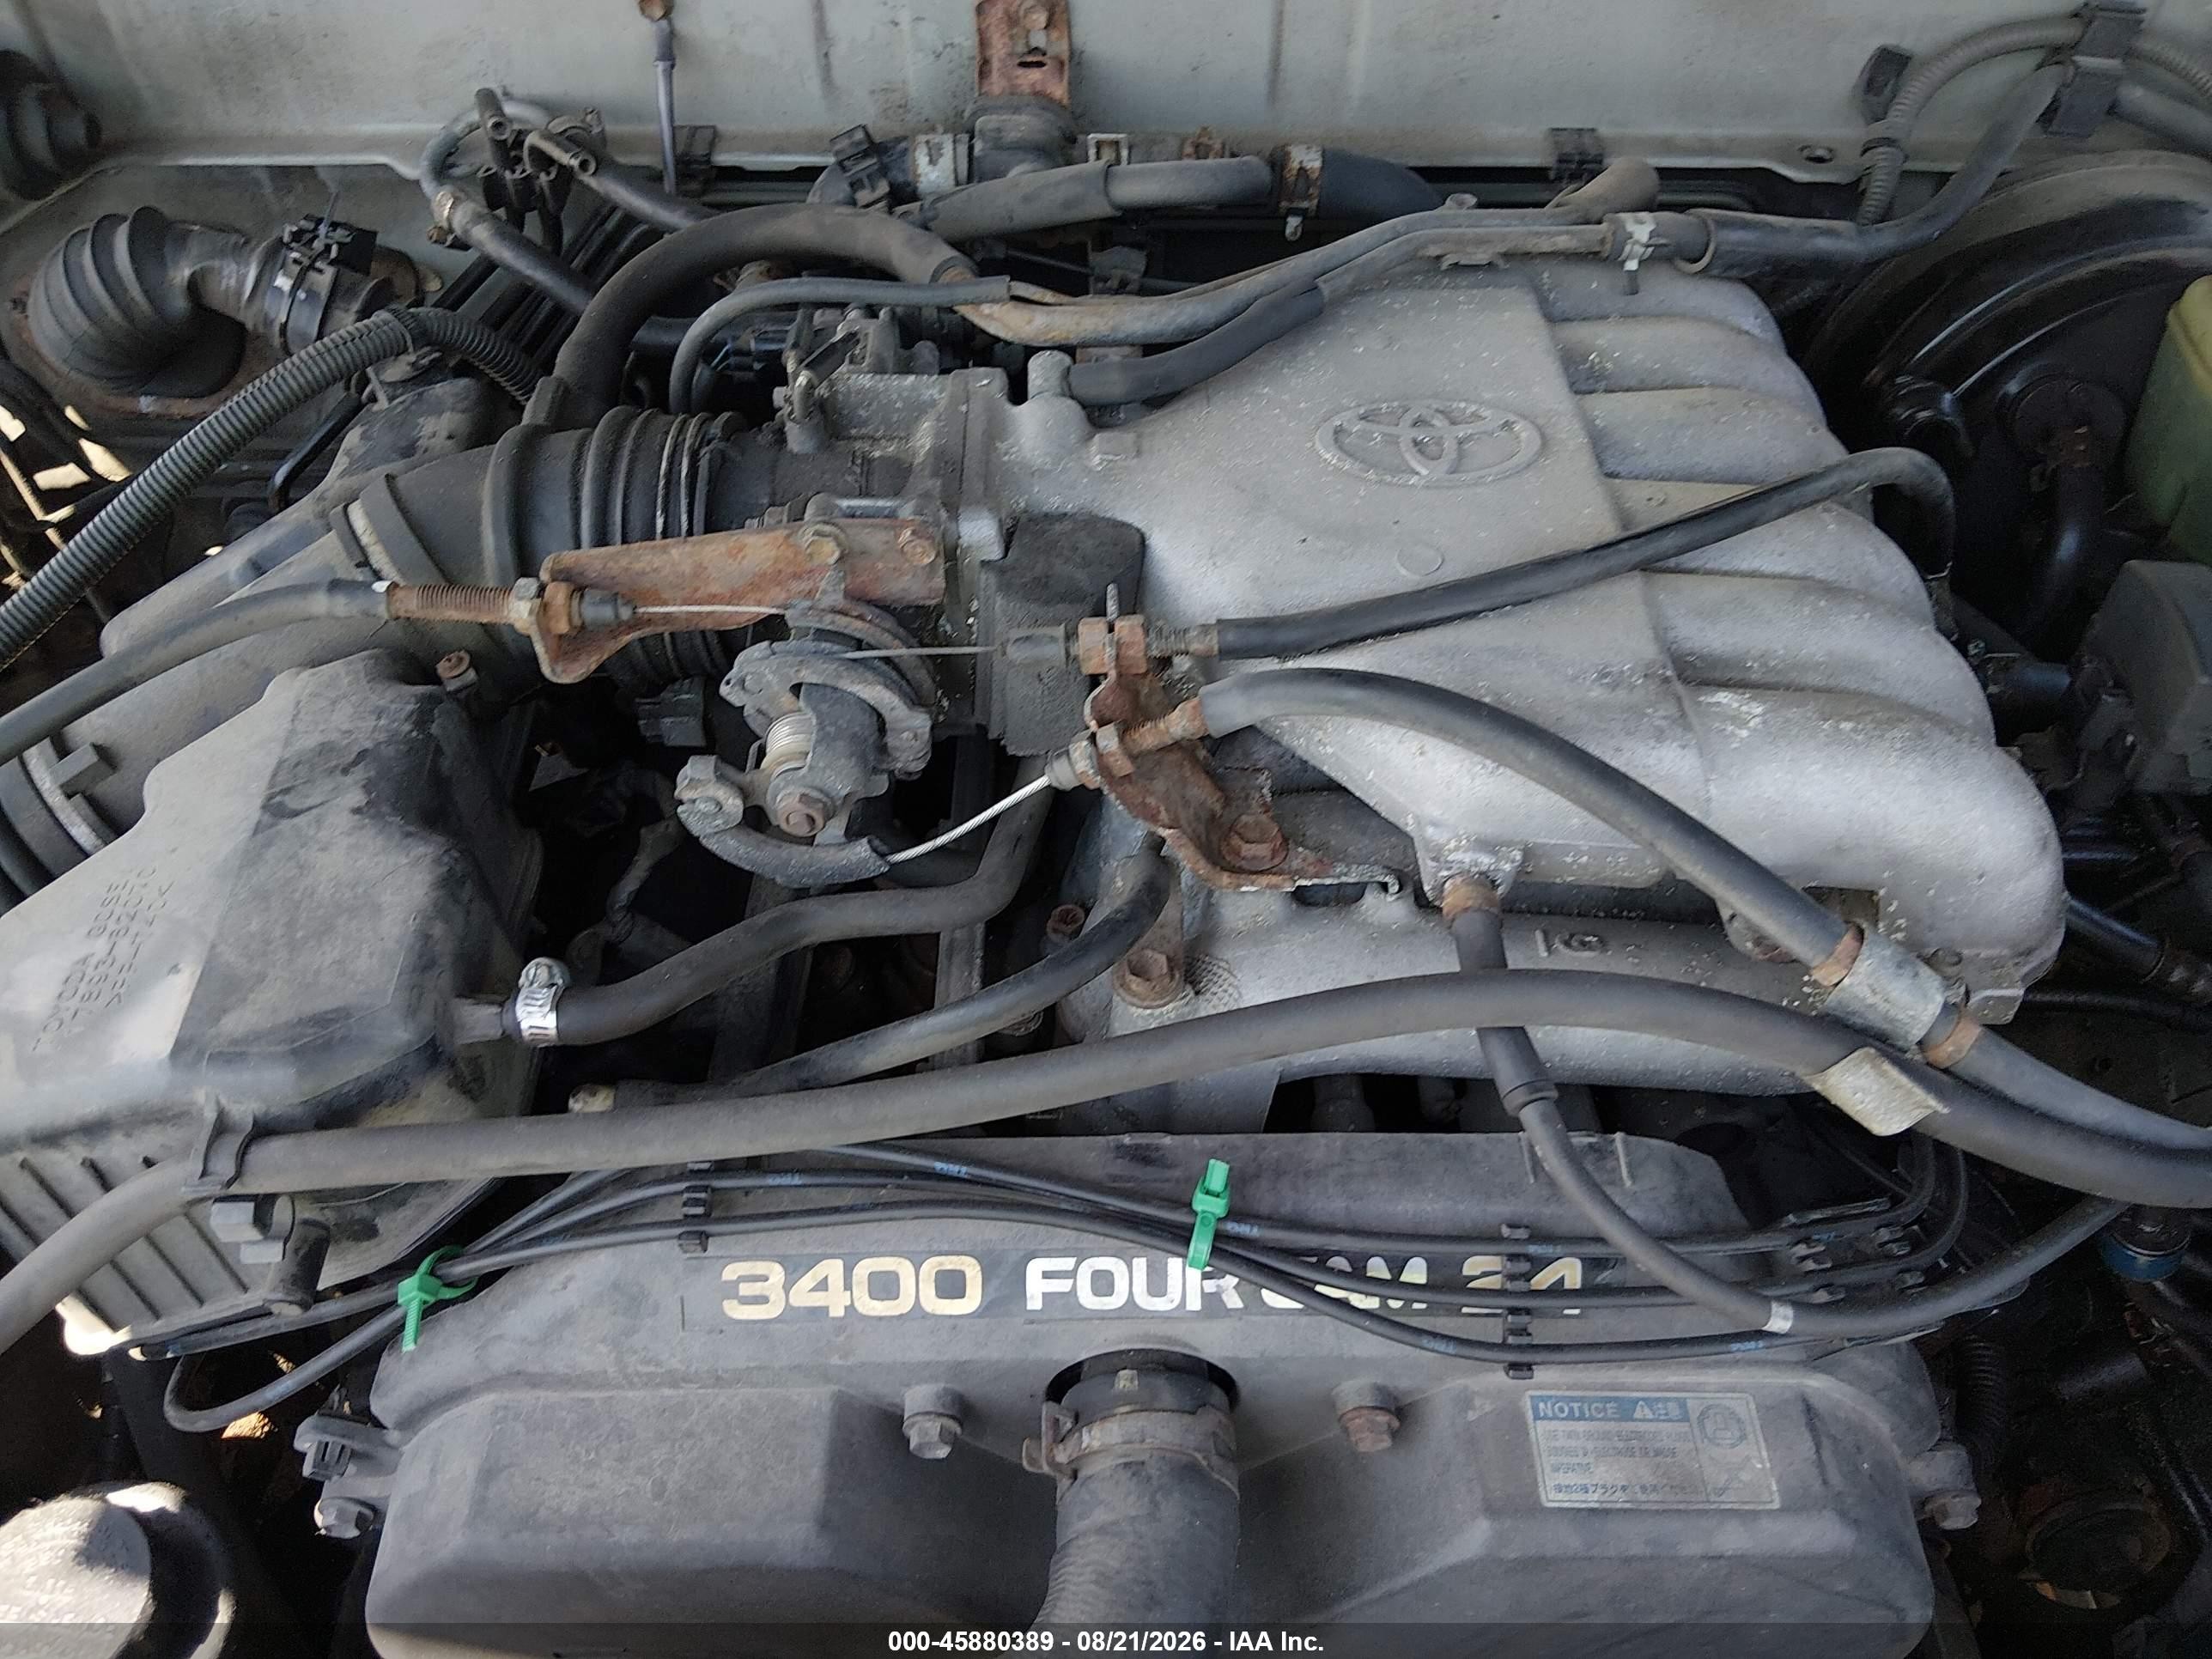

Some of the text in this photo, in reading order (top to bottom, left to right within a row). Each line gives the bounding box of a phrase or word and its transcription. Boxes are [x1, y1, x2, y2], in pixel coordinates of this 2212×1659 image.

[721, 1255, 982, 1320] 3400
[1025, 1255, 1244, 1312] FOUR
[1538, 1401, 1620, 1418] NOTICE
